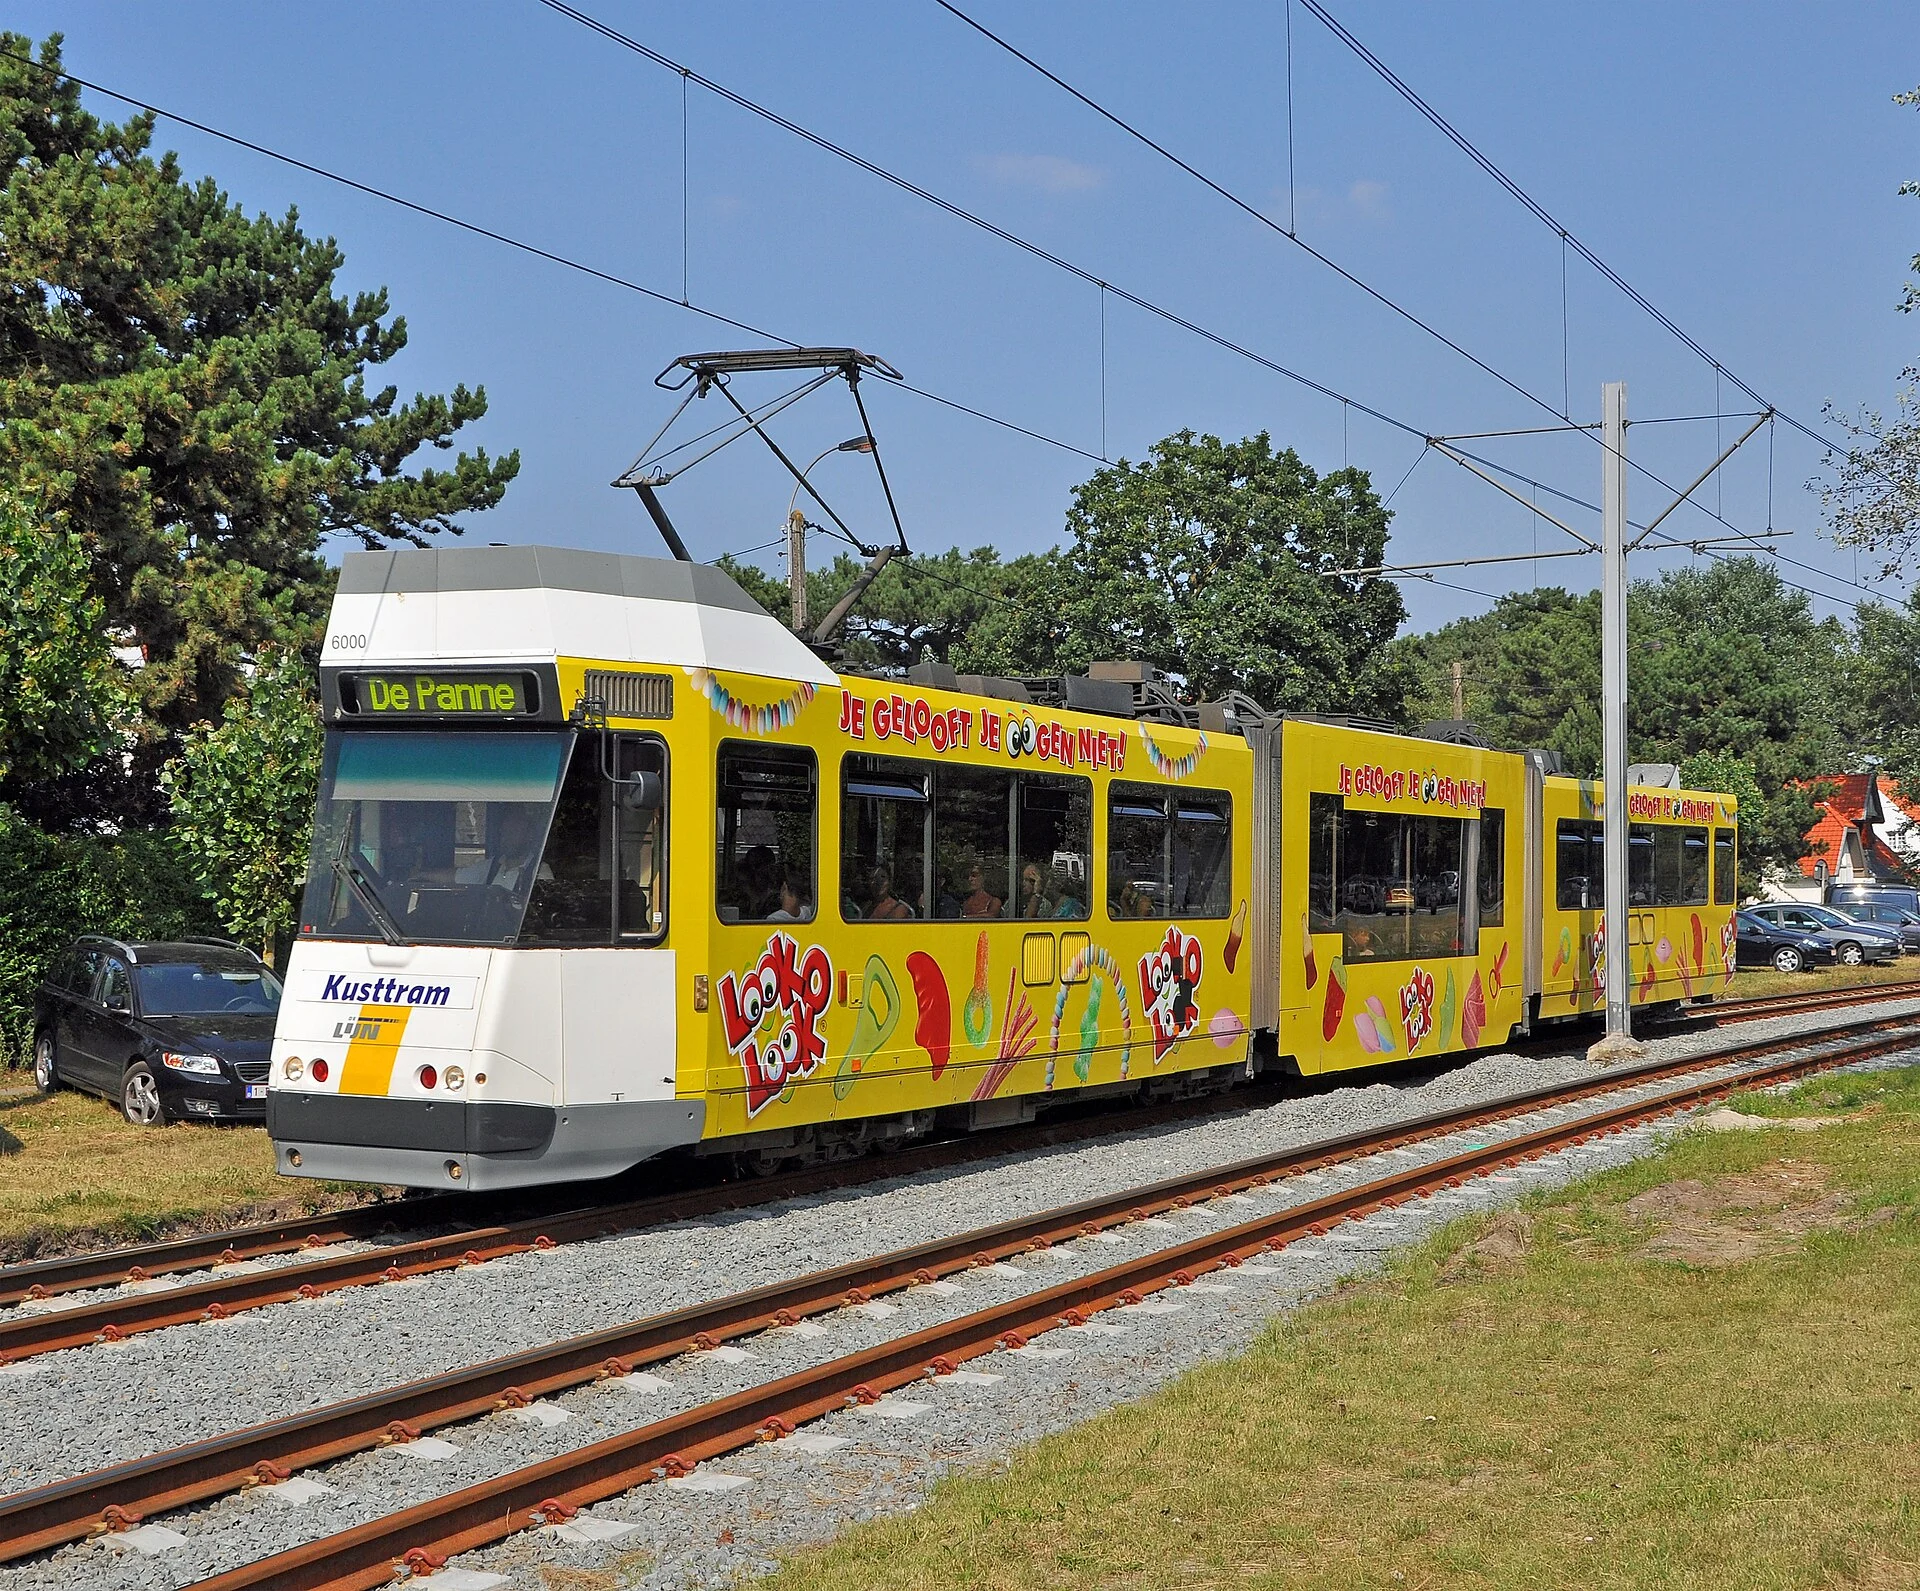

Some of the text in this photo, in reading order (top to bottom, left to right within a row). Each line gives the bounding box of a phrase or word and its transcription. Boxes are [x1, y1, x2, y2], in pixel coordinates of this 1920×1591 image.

[332, 634, 367, 650] 6000
[368, 675, 516, 711] De Panne
[838, 689, 866, 739] JE
[871, 694, 972, 753] GELOOFT
[978, 708, 1001, 752] JE
[1077, 727, 1127, 772] NIET!
[1338, 762, 1352, 797] JE
[1354, 763, 1405, 802] GELOOFT
[1407, 768, 1420, 800] JE
[1459, 778, 1487, 810] NIET!
[1629, 791, 1661, 821] GELOOFT
[1663, 794, 1671, 817] JE
[321, 974, 451, 1006] Kusttram
